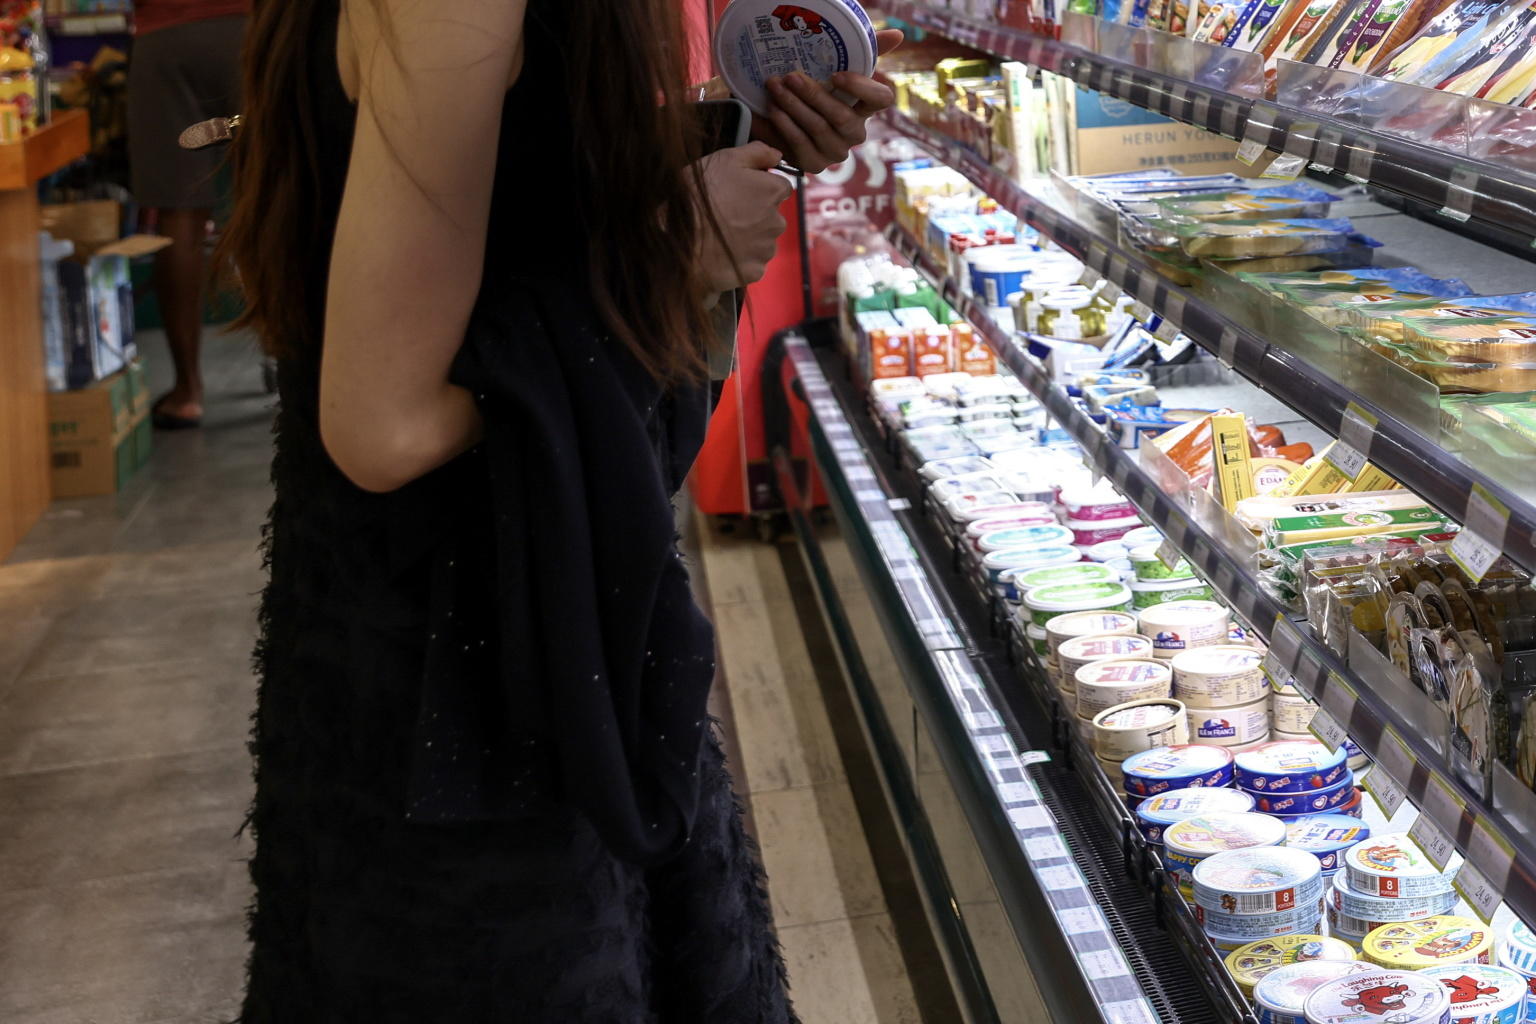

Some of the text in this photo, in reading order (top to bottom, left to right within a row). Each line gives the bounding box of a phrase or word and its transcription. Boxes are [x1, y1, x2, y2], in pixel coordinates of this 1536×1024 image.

[1122, 130, 1178, 146] HERUN
[1386, 880, 1394, 891] 8
[1282, 892, 1290, 902] 8
[1474, 884, 1493, 908] 24.90
[1342, 975, 1385, 989] Laughing
